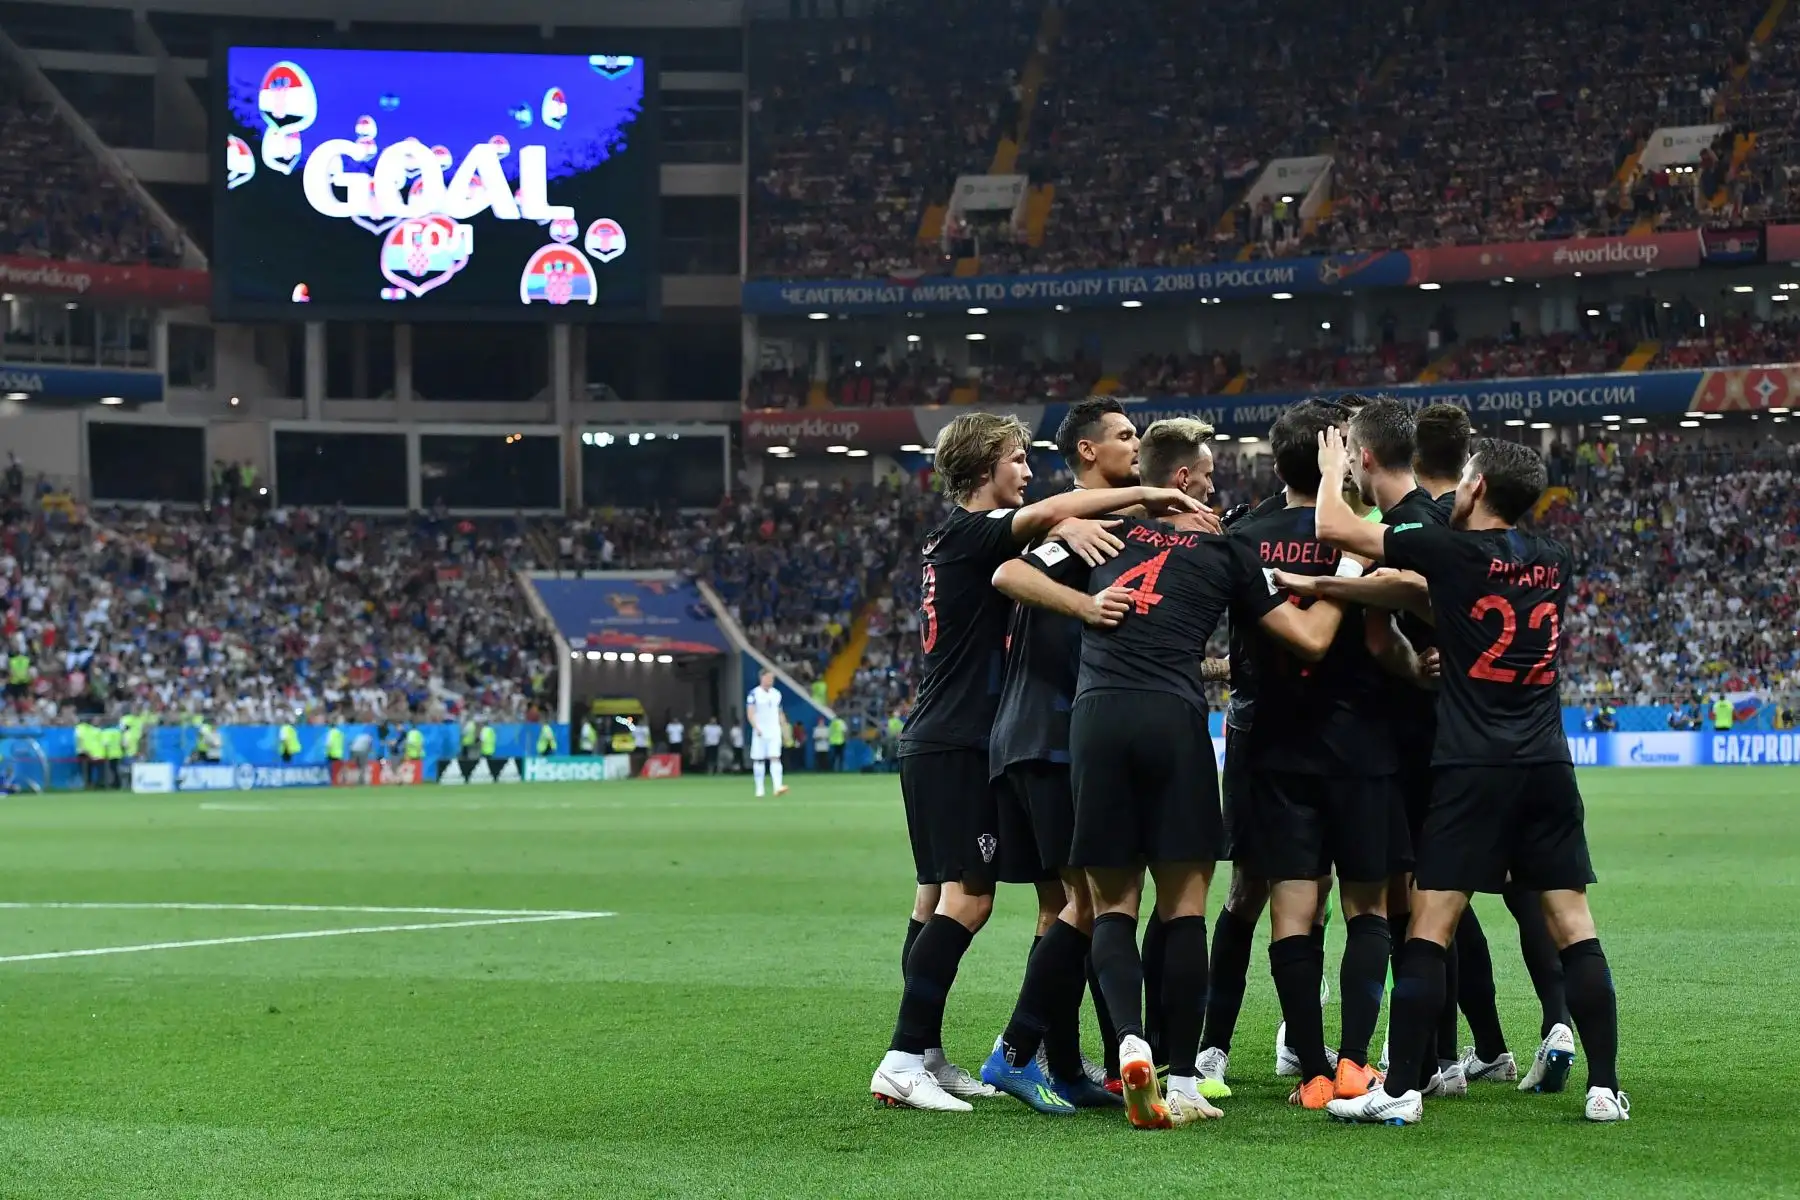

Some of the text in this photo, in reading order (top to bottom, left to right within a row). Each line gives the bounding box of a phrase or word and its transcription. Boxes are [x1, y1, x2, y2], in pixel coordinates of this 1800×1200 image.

[303, 138, 575, 220] GOAL
[1553, 242, 1659, 265] #worldcup
[781, 286, 906, 305] ЧЕМПИОНАТ
[911, 285, 971, 302] МИРА
[976, 283, 1005, 299] ПО
[1010, 279, 1101, 299] ФУТБОЛУ
[1107, 276, 1147, 294] FIFA
[1152, 273, 1194, 292] 2018
[1215, 266, 1298, 287] РОССИИ
[1477, 392, 1524, 411] 2018
[1548, 386, 1635, 406] РОССИИ
[748, 418, 860, 441] #worldcup
[1260, 541, 1337, 565] BADELJ
[1111, 547, 1172, 615] 4
[1468, 594, 1559, 685] 22
[525, 757, 602, 782] Hisense
